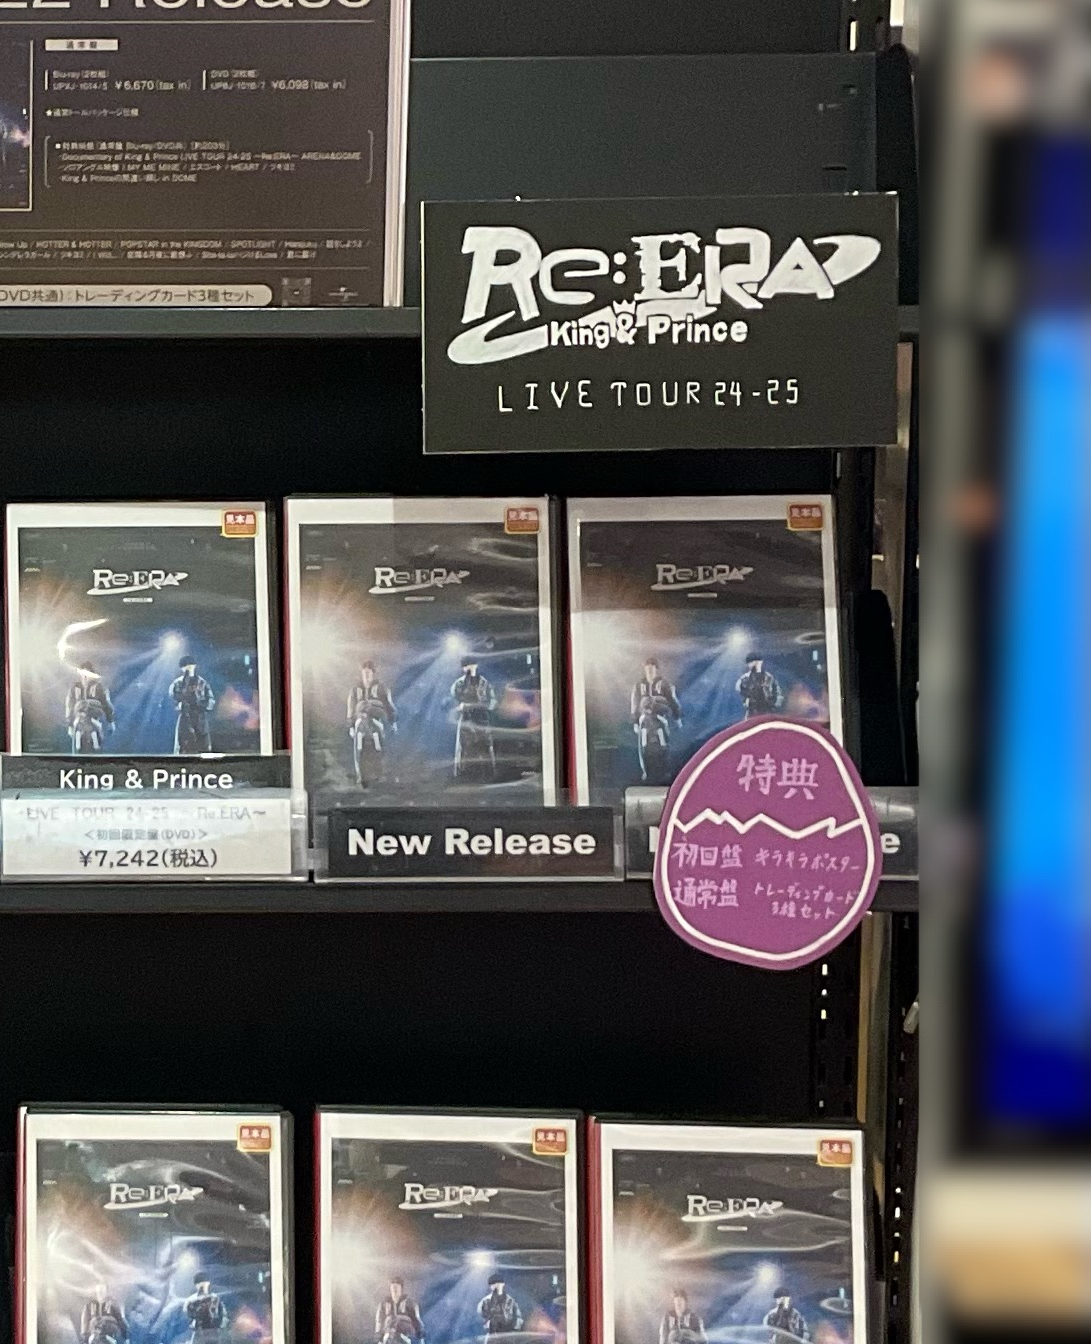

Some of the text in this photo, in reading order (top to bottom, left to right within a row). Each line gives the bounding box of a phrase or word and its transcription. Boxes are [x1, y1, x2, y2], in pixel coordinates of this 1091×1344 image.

[550, 315, 748, 348] King & Prince
[498, 378, 799, 412] LIVE TOUR 24-25
[59, 769, 234, 790] King & Prince
[736, 753, 819, 800] 特典
[348, 828, 597, 856] New Release
[671, 835, 743, 868] 初回盤
[673, 877, 739, 909] 通常盤
